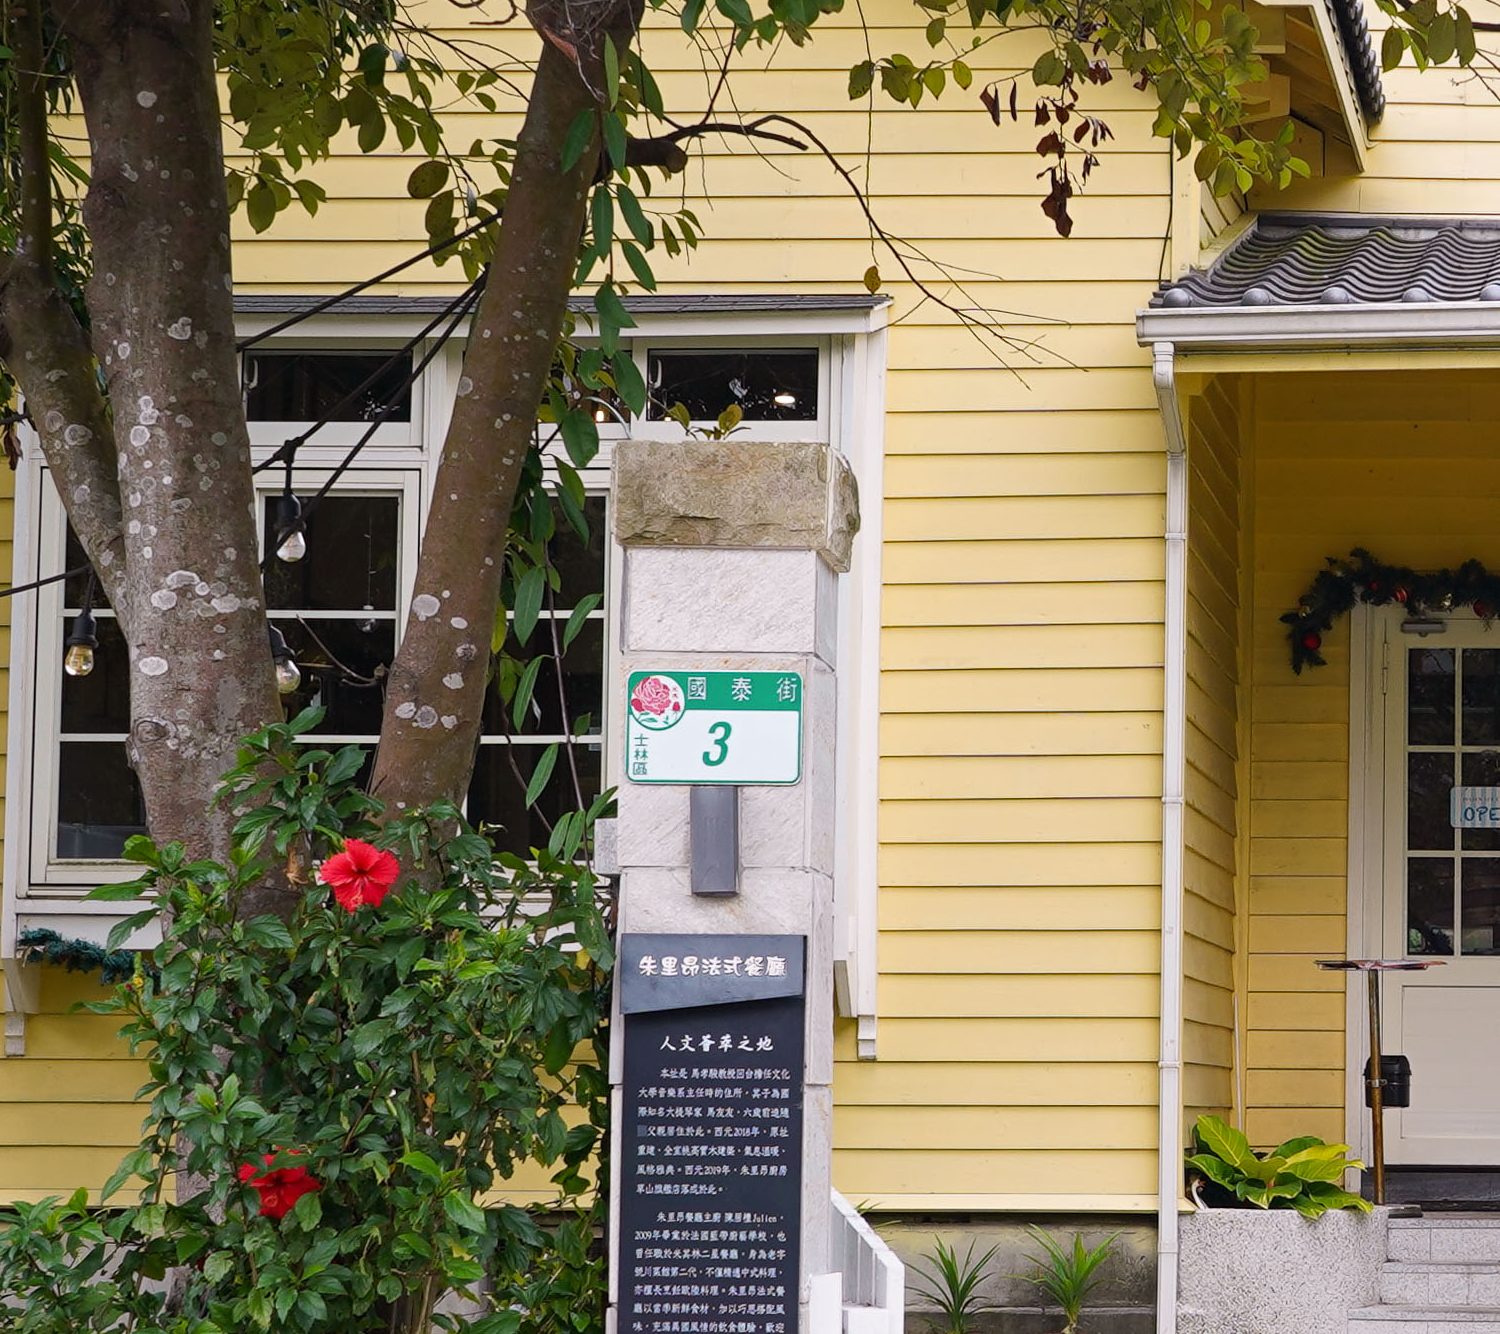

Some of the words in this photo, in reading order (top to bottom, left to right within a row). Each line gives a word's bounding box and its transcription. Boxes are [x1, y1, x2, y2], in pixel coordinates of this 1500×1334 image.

[688, 677, 798, 703] 國泰街
[632, 734, 648, 775] 士林區
[702, 722, 732, 766] 3
[639, 956, 785, 976] 朱里昂法式餐廳
[661, 1034, 773, 1052] 人文薈萃之地
